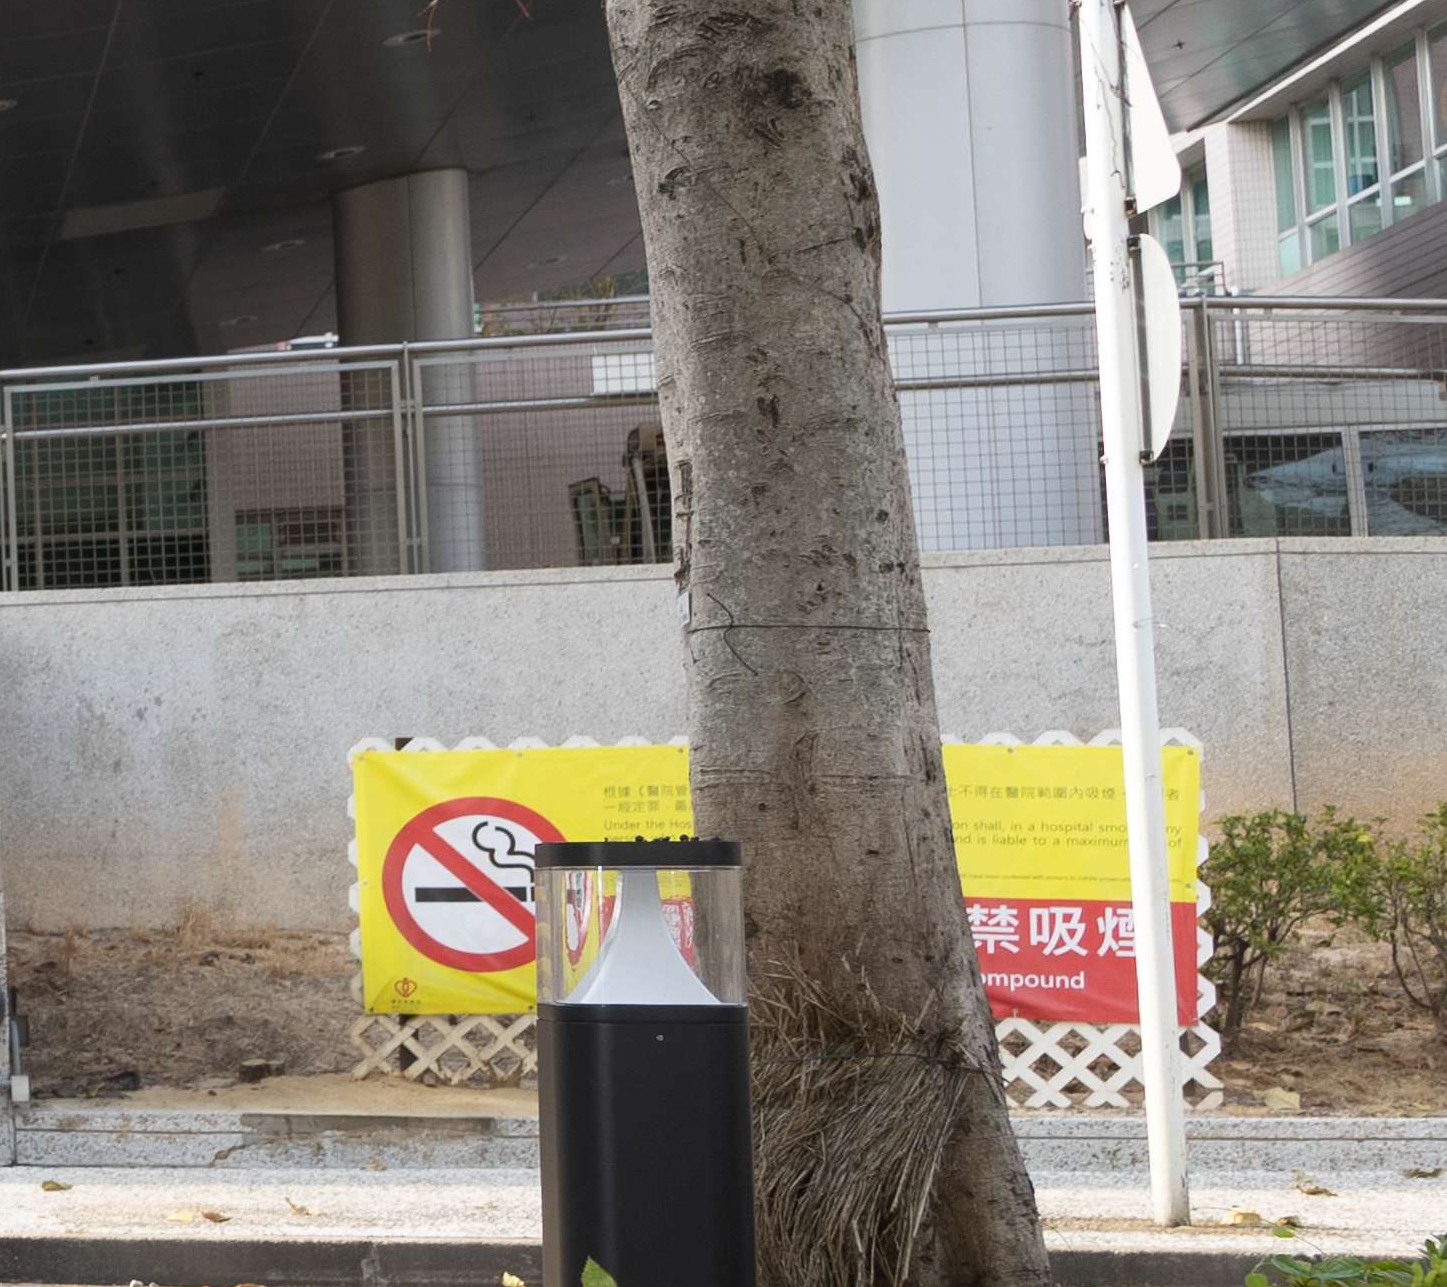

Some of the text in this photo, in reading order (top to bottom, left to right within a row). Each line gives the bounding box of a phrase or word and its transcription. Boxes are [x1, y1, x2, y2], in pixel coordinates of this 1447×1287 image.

[603, 819, 640, 831] Under
[646, 819, 665, 830] the
[1010, 820, 1022, 832] in
[1027, 823, 1035, 832] a
[1041, 820, 1094, 835] hospital
[1098, 824, 1127, 834] smo
[1166, 825, 1183, 837] ny
[955, 834, 971, 845] nd
[977, 835, 987, 845] is
[992, 834, 1027, 846] liable
[1033, 836, 1047, 846] to
[1052, 838, 1061, 847] a
[1168, 837, 1183, 849] of
[980, 970, 1086, 992] mpound
